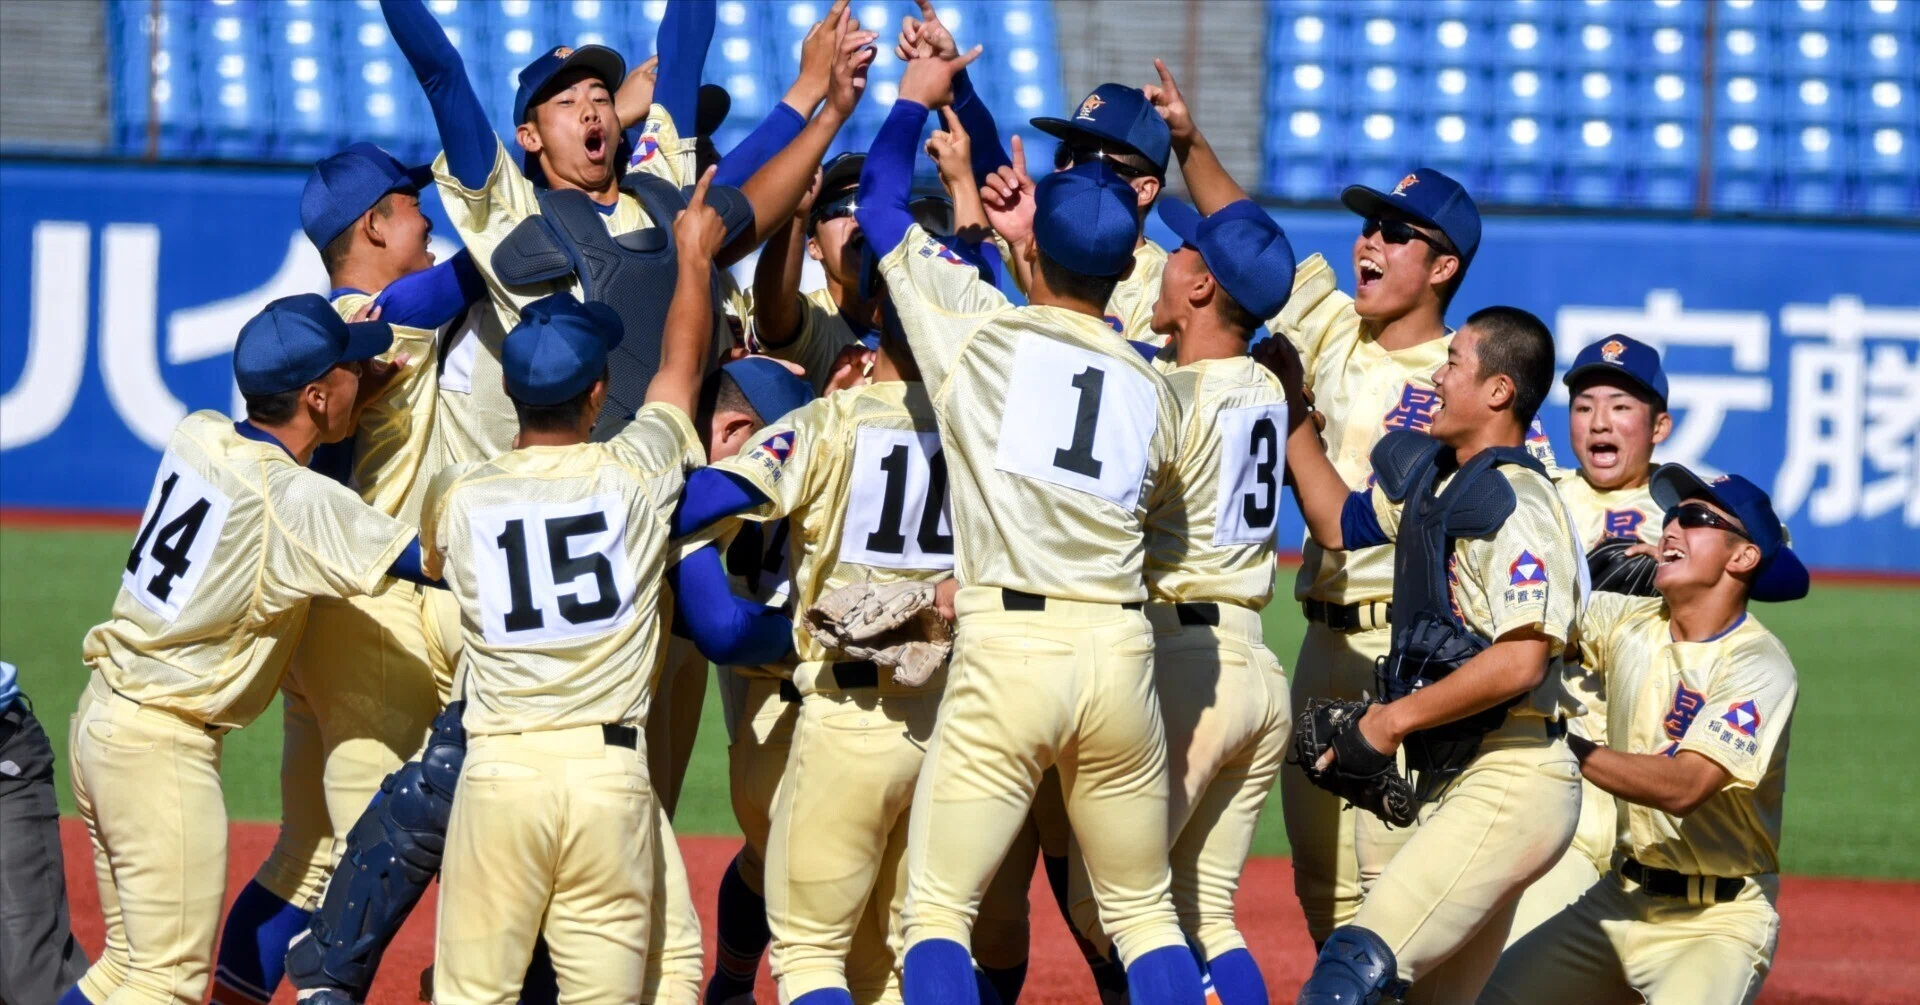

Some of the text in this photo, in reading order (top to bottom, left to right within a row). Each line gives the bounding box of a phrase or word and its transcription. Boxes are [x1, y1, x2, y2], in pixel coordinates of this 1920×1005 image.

[1053, 365, 1104, 479] 1
[1243, 418, 1277, 528] 3
[126, 471, 212, 603] 14
[497, 511, 622, 633] 15
